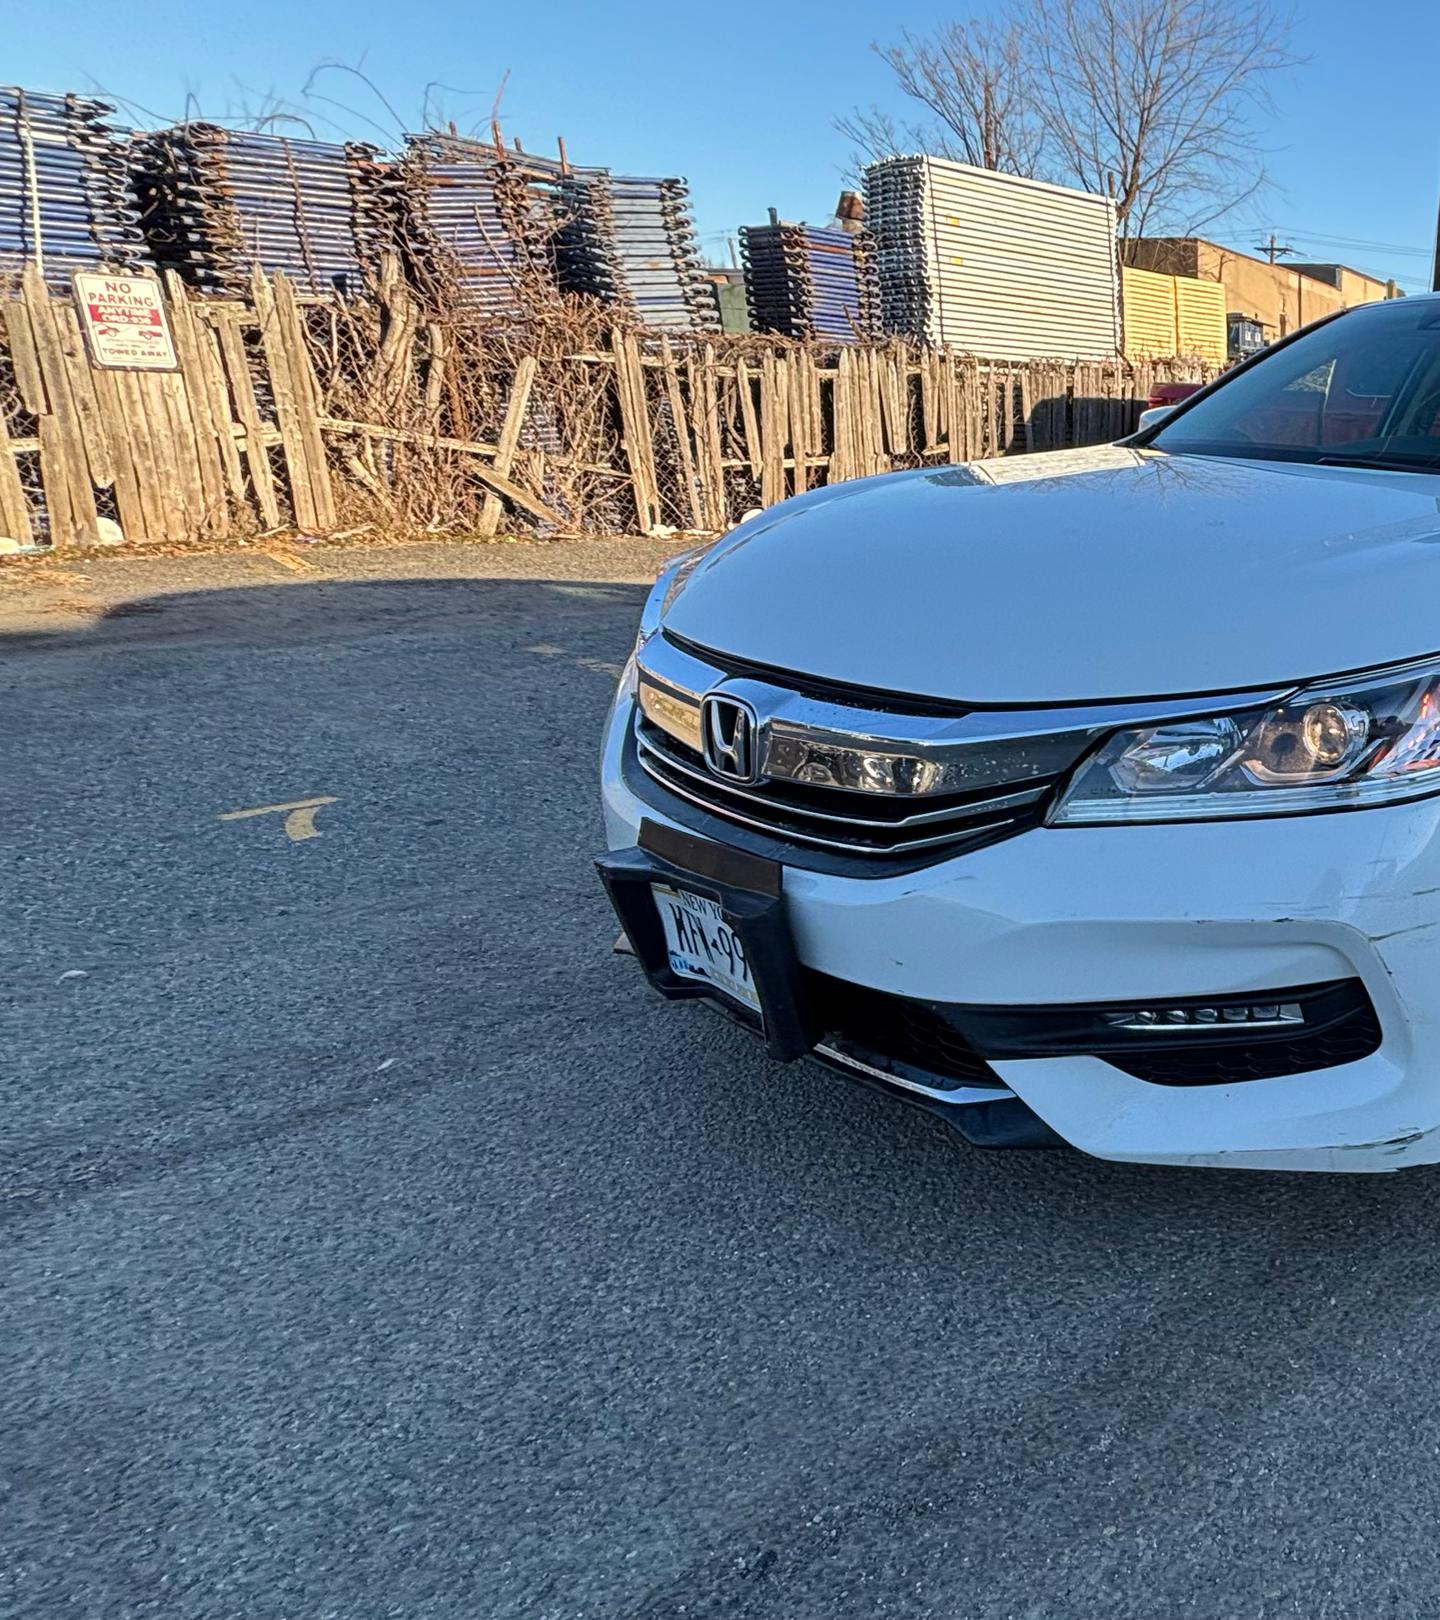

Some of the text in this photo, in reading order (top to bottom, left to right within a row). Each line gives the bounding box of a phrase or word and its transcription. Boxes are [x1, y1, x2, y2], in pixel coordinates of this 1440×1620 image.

[105, 281, 131, 294] NO
[88, 292, 154, 307] PARKING
[98, 305, 152, 318] ANYTIME
[102, 347, 167, 358] TOWED AWAY
[680, 891, 707, 916] NEW
